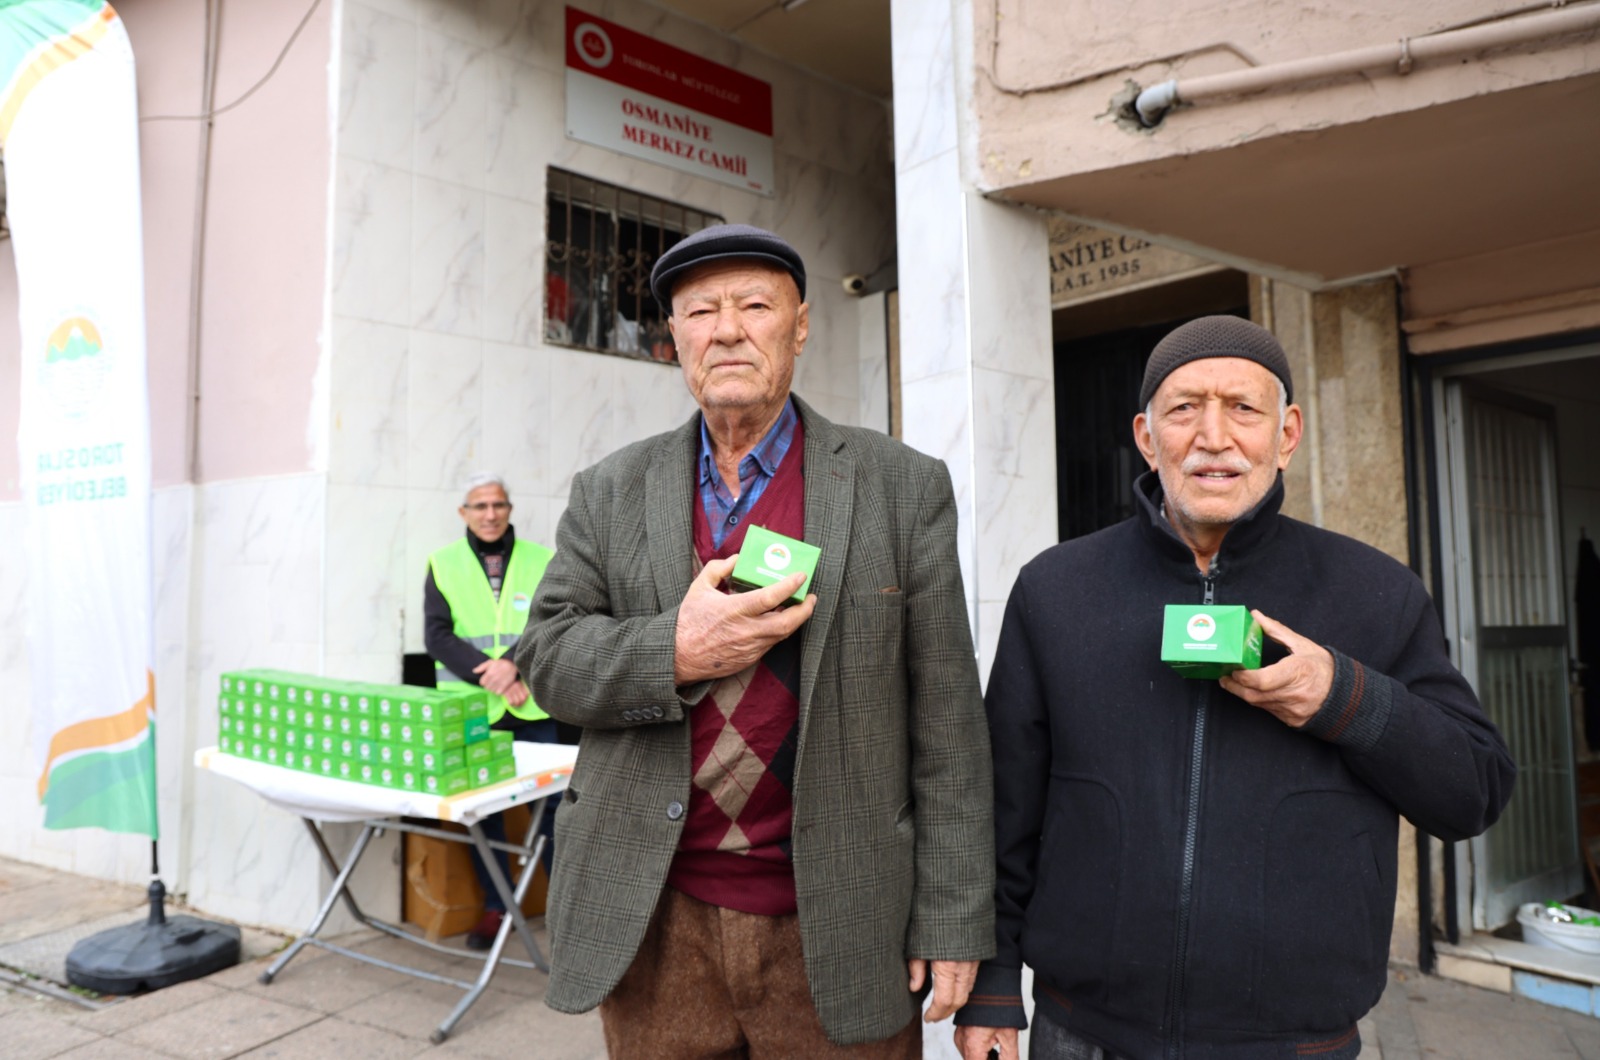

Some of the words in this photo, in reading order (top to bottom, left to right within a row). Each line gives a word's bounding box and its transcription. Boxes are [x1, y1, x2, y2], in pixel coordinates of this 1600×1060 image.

[621, 98, 712, 142] OSMANİYE
[622, 123, 696, 161] MERKEZ
[699, 147, 747, 177] CAMİİ
[1100, 258, 1140, 282] 1935
